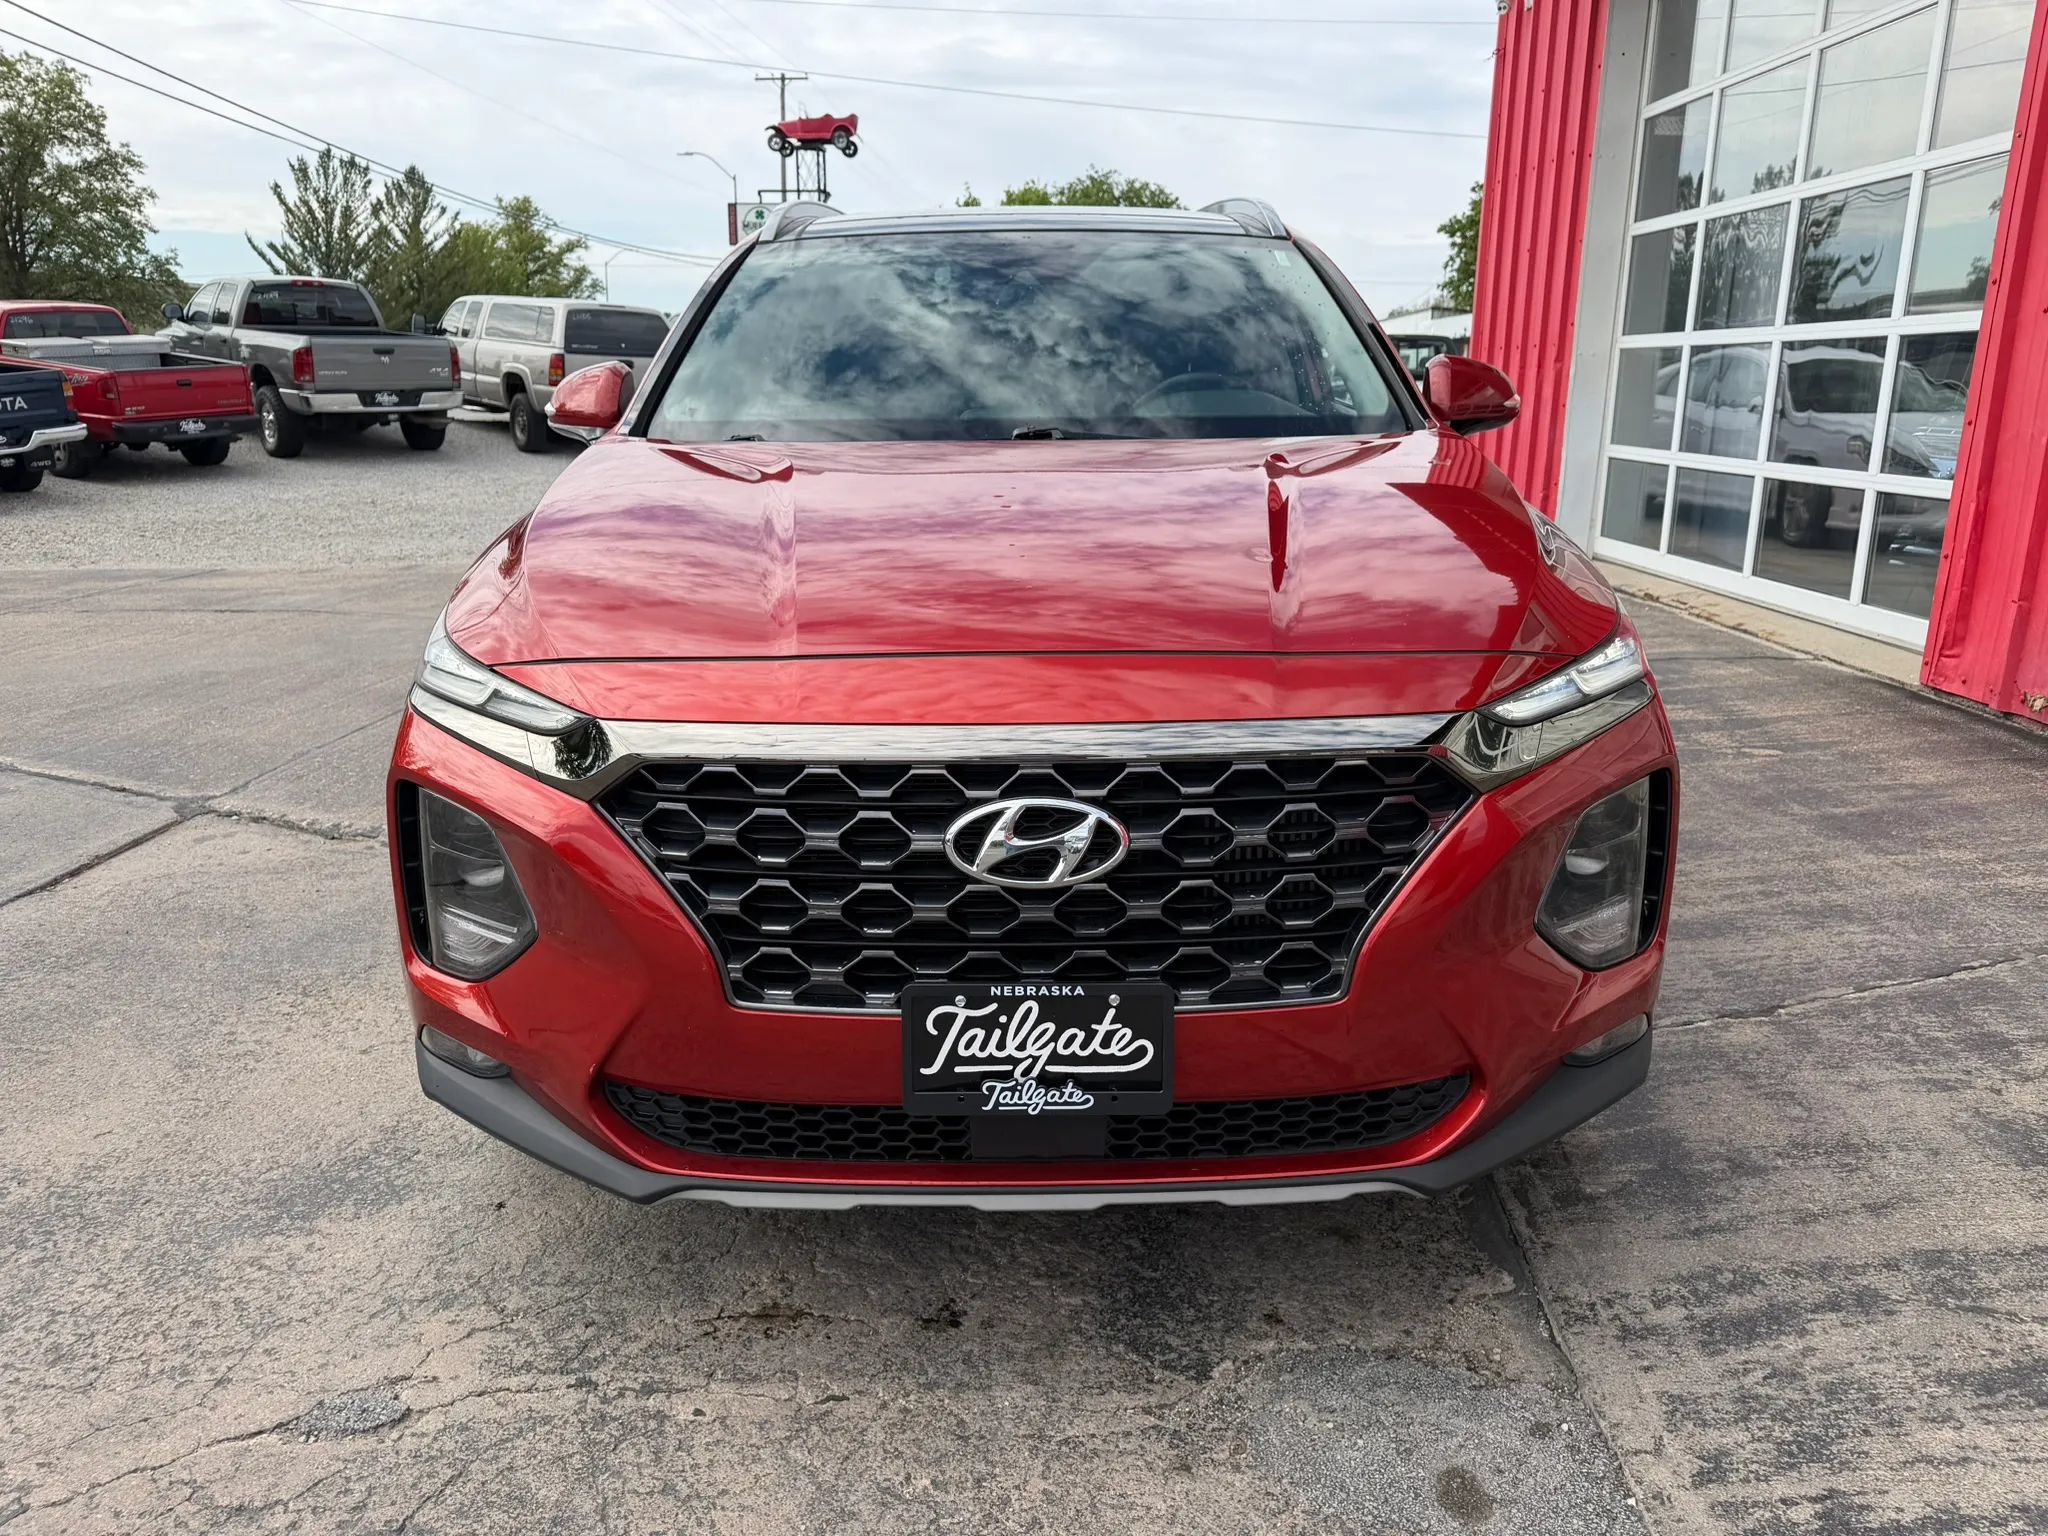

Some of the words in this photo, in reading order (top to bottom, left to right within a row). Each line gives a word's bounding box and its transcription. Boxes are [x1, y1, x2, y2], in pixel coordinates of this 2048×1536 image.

[0, 396, 28, 411] TA
[990, 985, 1085, 996] NEBRASKA
[919, 999, 1154, 1082] Tailgate
[981, 1079, 1095, 1115] Tailgate
